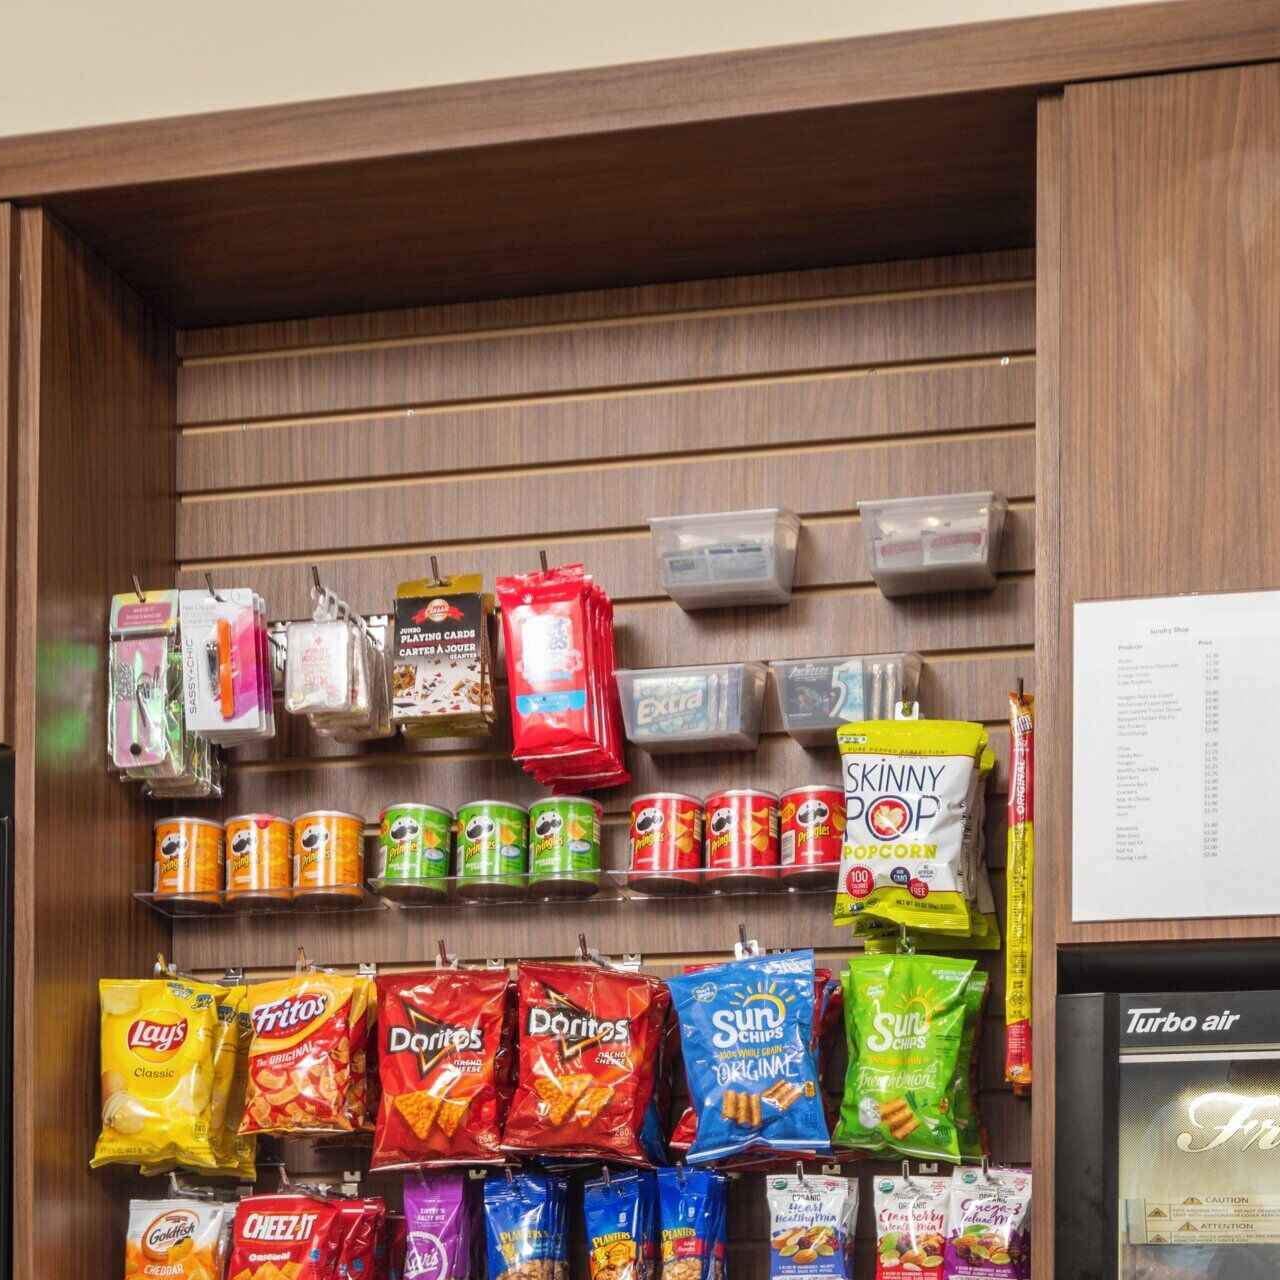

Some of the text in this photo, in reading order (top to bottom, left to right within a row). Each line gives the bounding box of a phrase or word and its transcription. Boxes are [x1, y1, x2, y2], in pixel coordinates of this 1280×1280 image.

[401, 629, 476, 643] PLAYING CARDS
[399, 643, 476, 656] CARTES À JOUER
[185, 639, 197, 714] SASSY+CHIC
[829, 664, 849, 718] 5
[637, 687, 703, 725] Extra
[846, 758, 946, 793] SKINNY
[1016, 760, 1025, 815] ORIGINAL
[844, 794, 941, 842] POP
[844, 844, 939, 860] POPCORN
[851, 870, 869, 883] 100
[910, 886, 926, 896] FREE
[251, 993, 329, 1033] Fritos
[529, 1007, 628, 1041] Doritos
[1125, 1008, 1241, 1034] Turbo air
[129, 1017, 188, 1051] Lay's
[712, 1004, 785, 1049] Sun
[739, 1026, 784, 1044] CHIPS
[867, 1012, 928, 1053] Sun
[389, 1027, 483, 1053] Doritos
[892, 1036, 927, 1050] CHIPS
[256, 1041, 316, 1068] The ORIGINAL
[453, 1059, 482, 1067] NACHO
[595, 1058, 627, 1066] CHEESE
[719, 1045, 782, 1060] 100% WHOLE GRAIN
[134, 1066, 175, 1079] Classic
[717, 1056, 799, 1086] ORIGINAL
[1205, 1196, 1249, 1204] CAUTION
[149, 1221, 195, 1245] Goldfish
[592, 1231, 631, 1248] PLANTERS
[662, 1227, 696, 1241] PLANTERS
[144, 1264, 184, 1276] CHEDDAR
